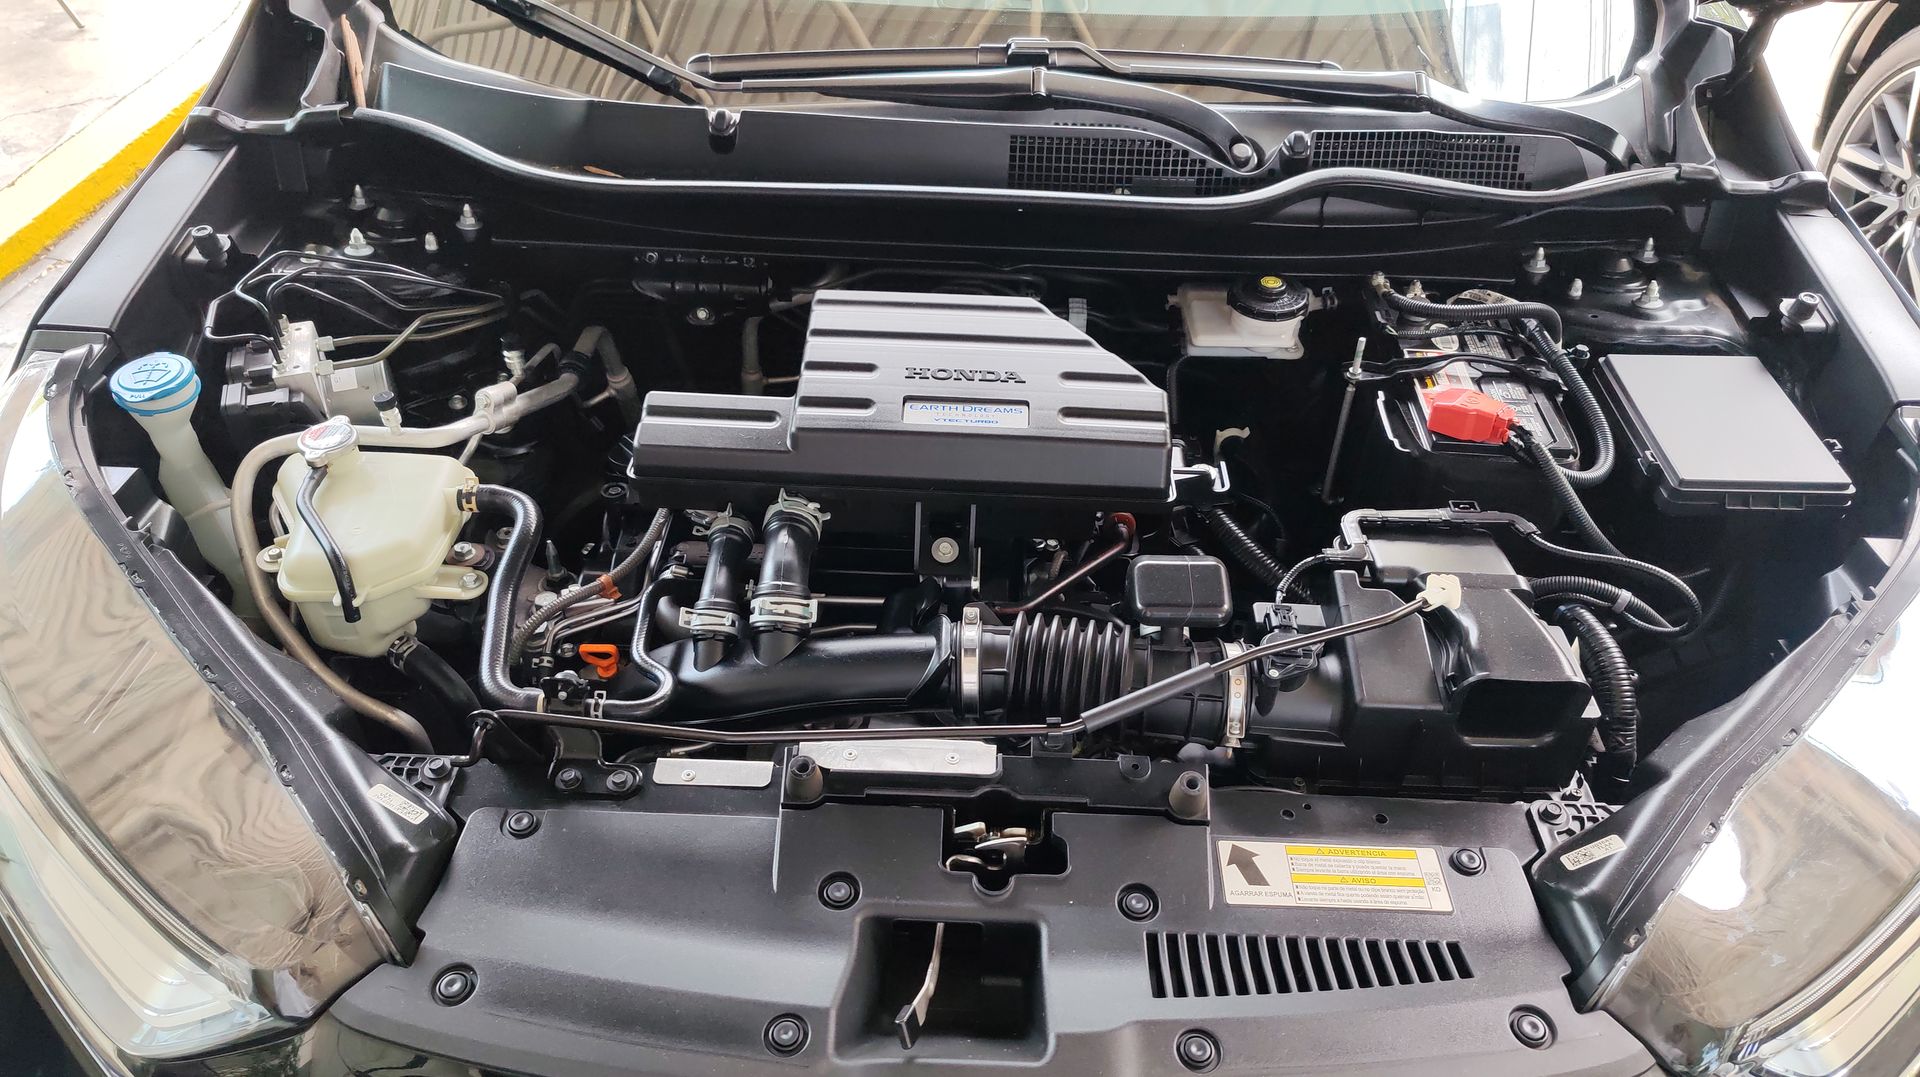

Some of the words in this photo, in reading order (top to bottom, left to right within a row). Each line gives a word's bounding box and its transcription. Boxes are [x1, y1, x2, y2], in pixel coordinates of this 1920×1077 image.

[905, 367, 1026, 383] HONDA
[962, 405, 1023, 414] DREAMS
[1328, 849, 1387, 857] ADVERTENCIA
